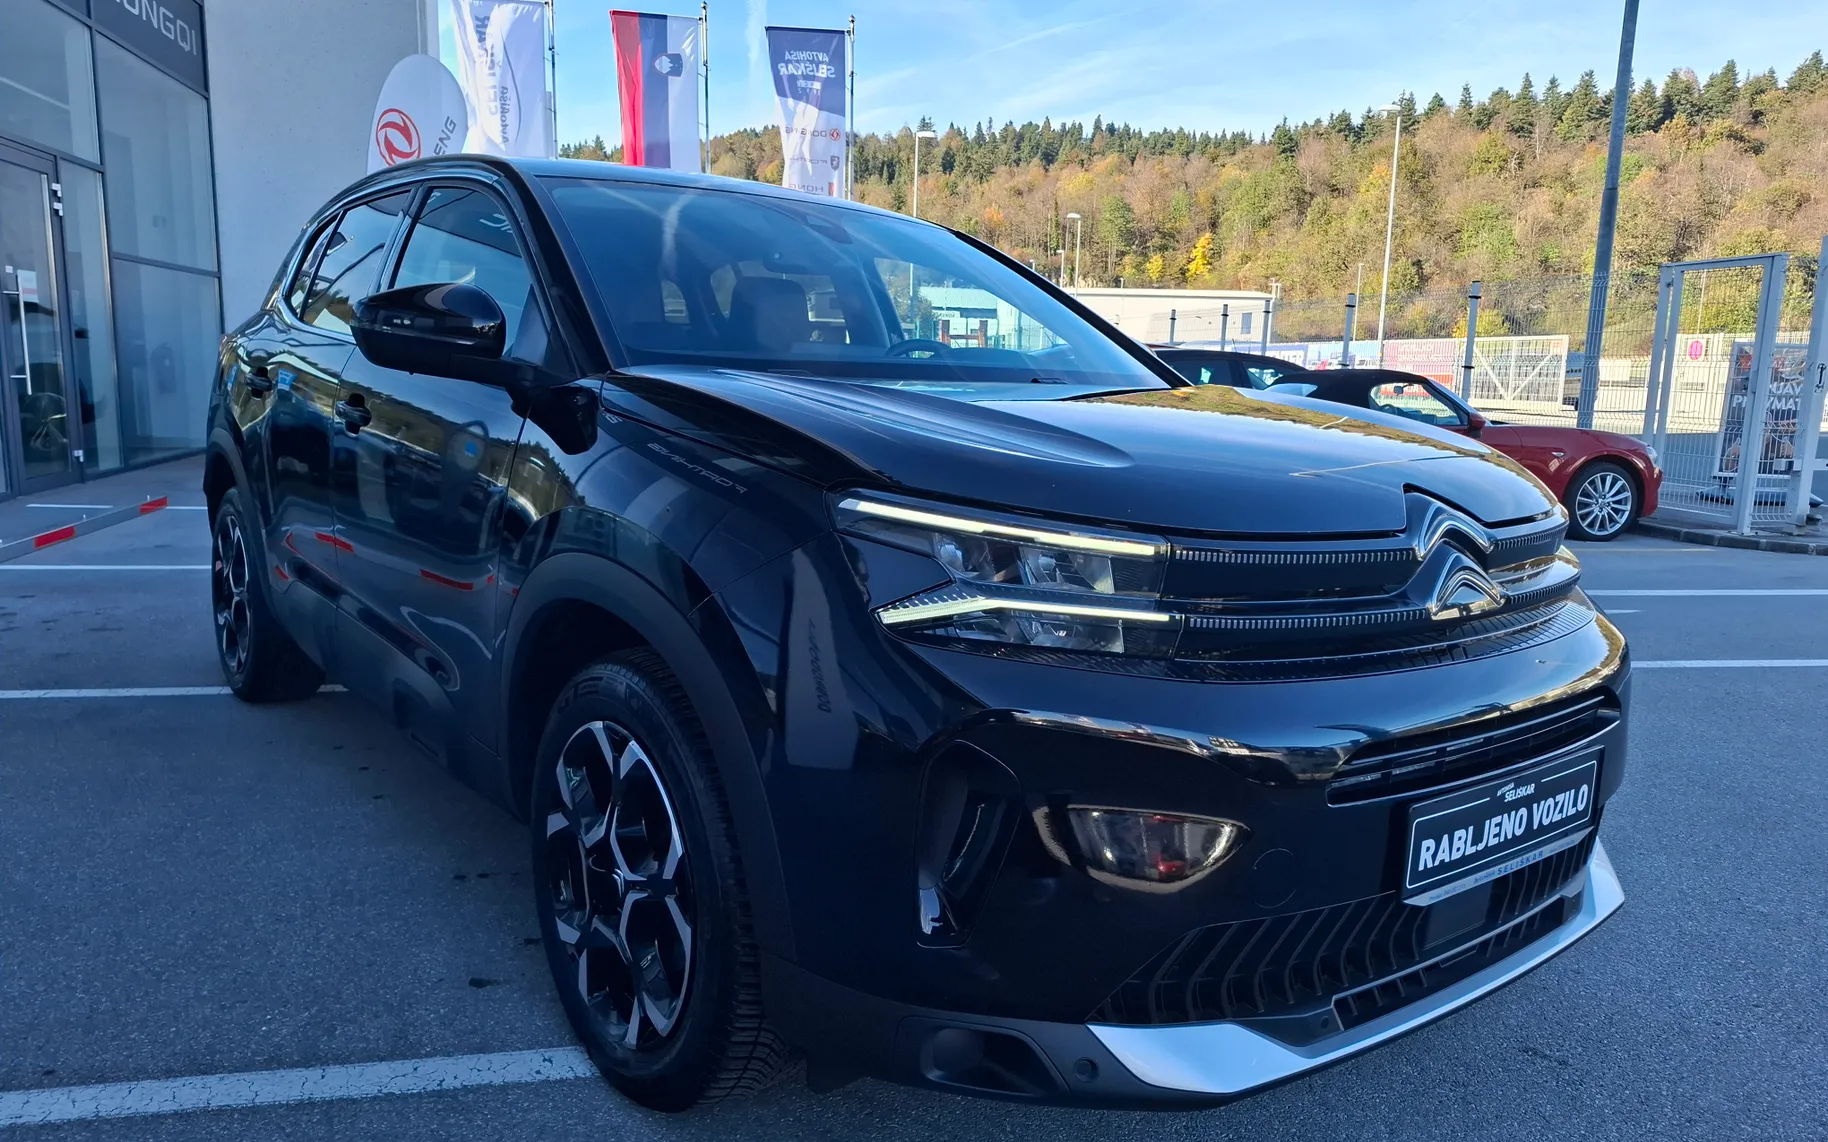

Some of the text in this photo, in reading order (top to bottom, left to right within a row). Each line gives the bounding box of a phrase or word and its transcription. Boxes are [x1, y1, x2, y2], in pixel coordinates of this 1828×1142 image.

[116, 0, 197, 55] NGQI
[1418, 784, 1588, 871] RABLJENO VOZILO
